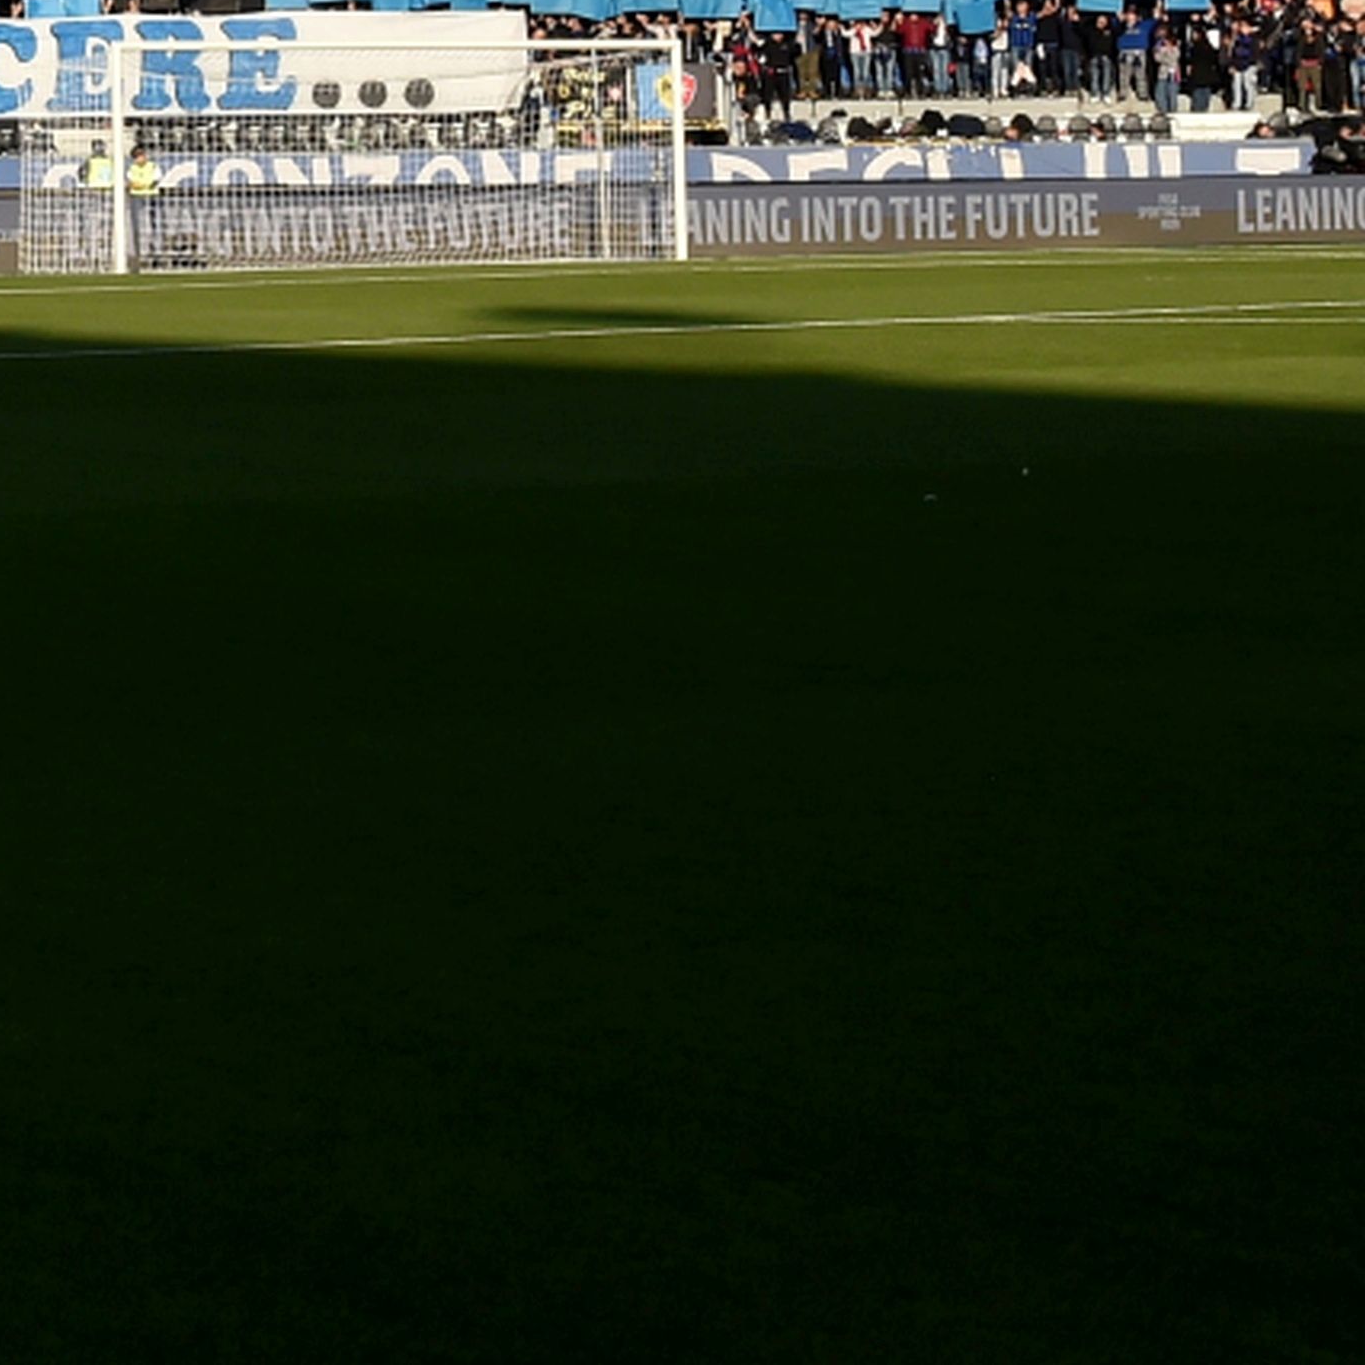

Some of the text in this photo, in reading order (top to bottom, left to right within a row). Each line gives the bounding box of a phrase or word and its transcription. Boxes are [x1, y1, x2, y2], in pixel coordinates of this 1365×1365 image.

[800, 195, 883, 243] INTO
[889, 194, 957, 240] THE
[966, 192, 1101, 238] FUTURE
